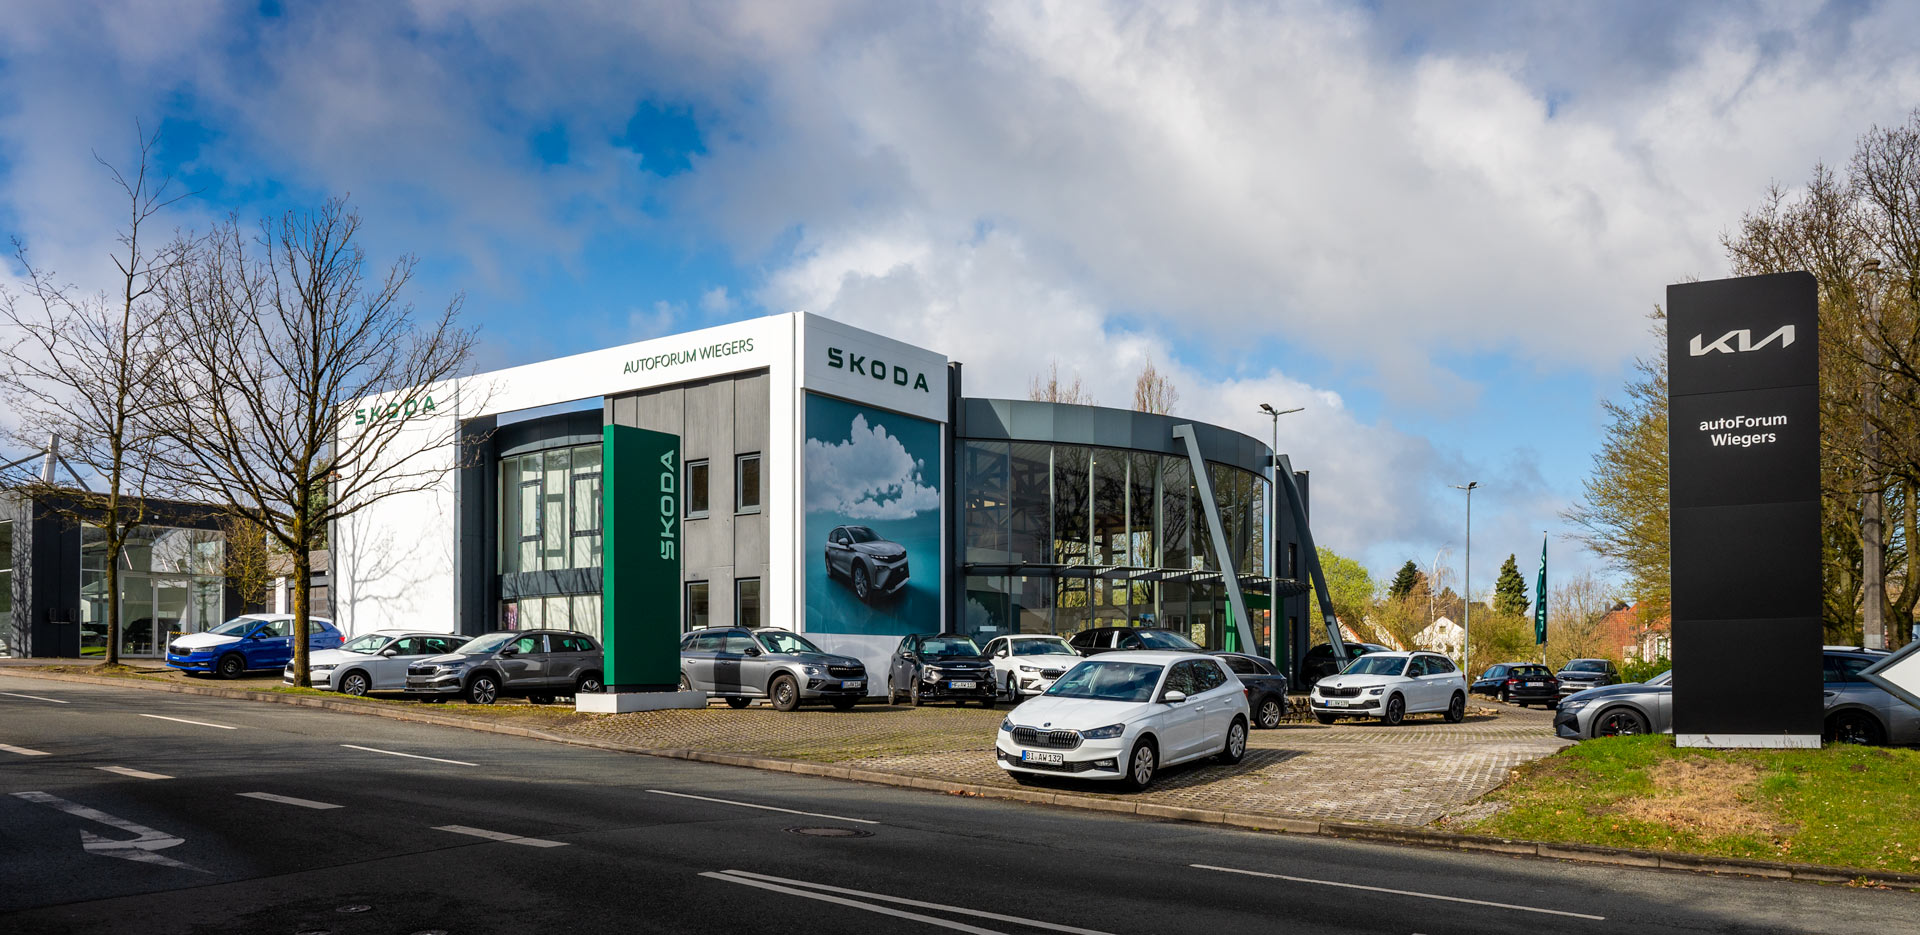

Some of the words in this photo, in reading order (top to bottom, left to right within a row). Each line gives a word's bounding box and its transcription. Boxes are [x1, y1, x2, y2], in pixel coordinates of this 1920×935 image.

[1689, 324, 1796, 357] KIA
[623, 349, 697, 375] AUTOFORUM
[699, 338, 754, 361] WIEGERS
[1699, 415, 1788, 431] autoForum
[1710, 432, 1777, 448] Wiegers
[1026, 751, 1034, 760] BI
[1038, 753, 1047, 762] AW
[1048, 754, 1062, 763] 132
